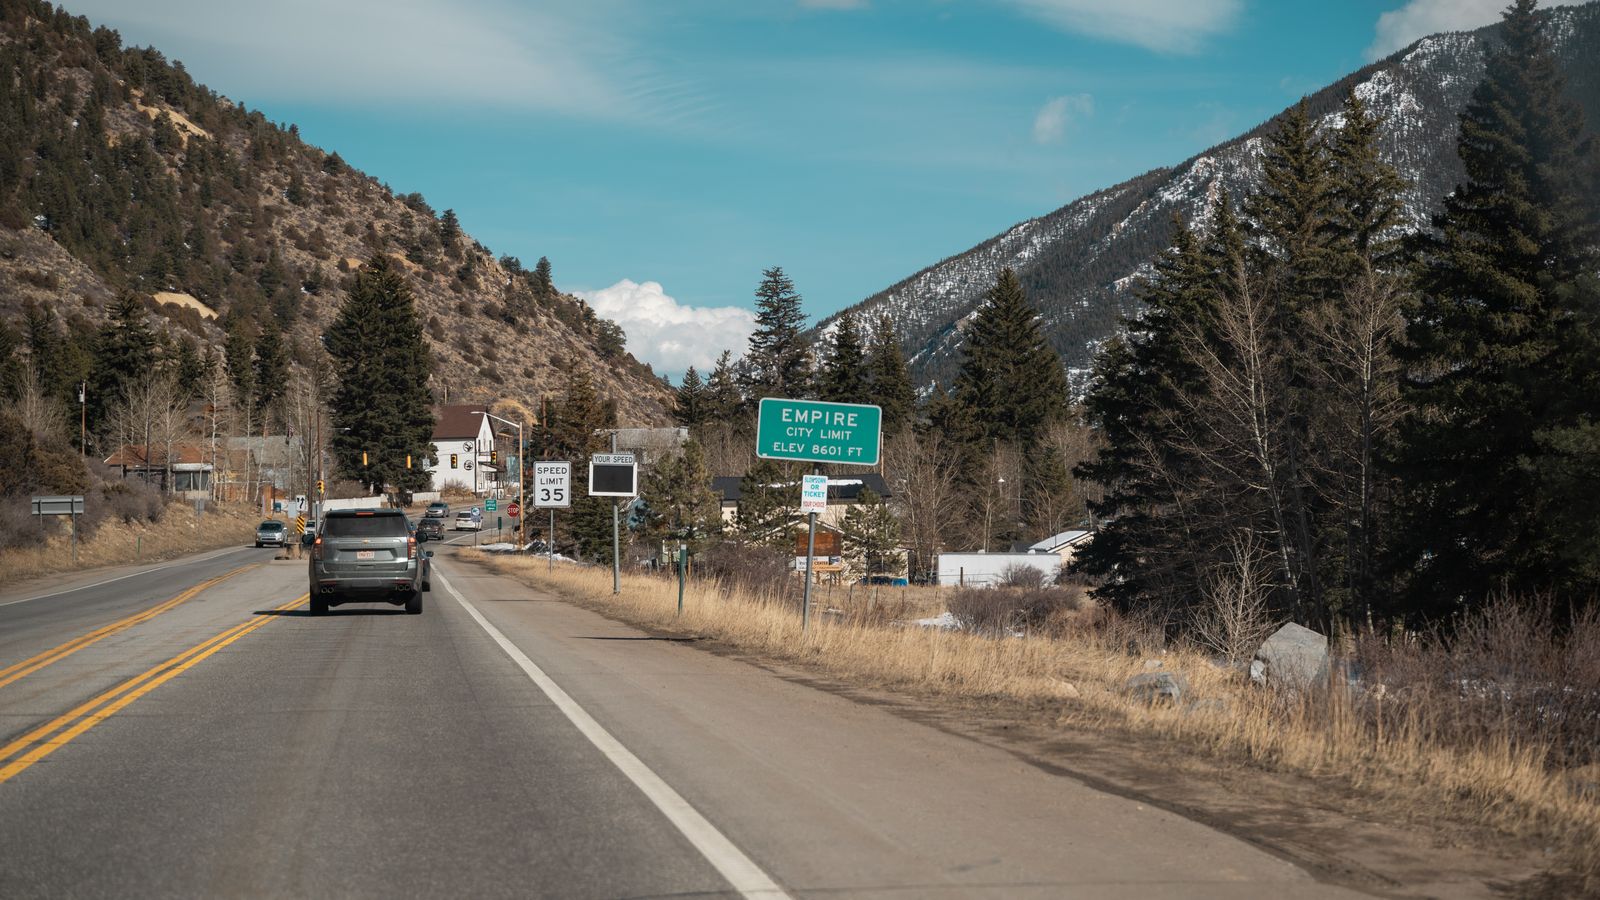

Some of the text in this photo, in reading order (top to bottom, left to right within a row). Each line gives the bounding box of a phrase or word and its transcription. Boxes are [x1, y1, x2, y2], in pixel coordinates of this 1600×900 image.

[782, 408, 858, 427] EMPIRE
[786, 426, 852, 440] CITY LIMIT
[773, 442, 863, 456] ELEV 8601 FT
[537, 466, 568, 474] SPEED
[540, 488, 564, 502] 35
